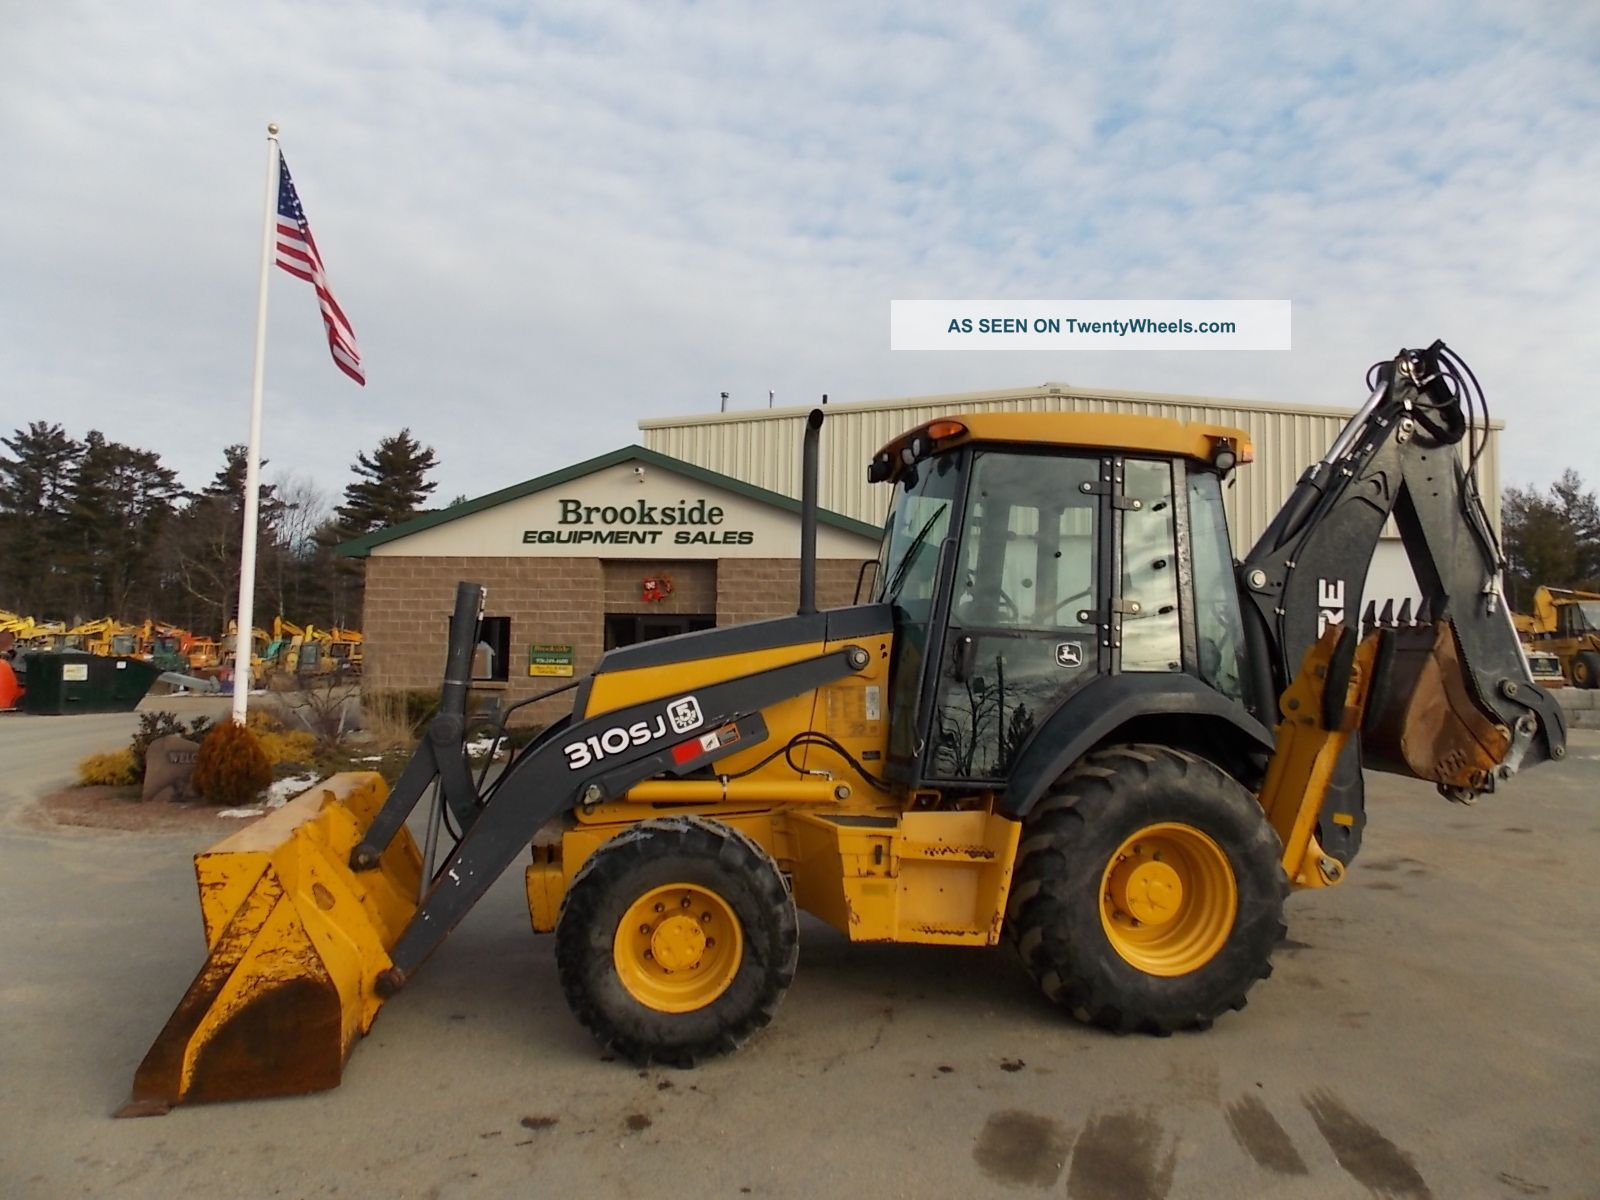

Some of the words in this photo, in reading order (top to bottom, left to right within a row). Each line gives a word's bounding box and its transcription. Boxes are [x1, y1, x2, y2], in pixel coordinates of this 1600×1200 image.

[558, 499, 724, 525] Brookside
[522, 530, 663, 545] EQUIPMENT
[673, 530, 754, 545] SALES
[563, 714, 667, 770] 310SJ
